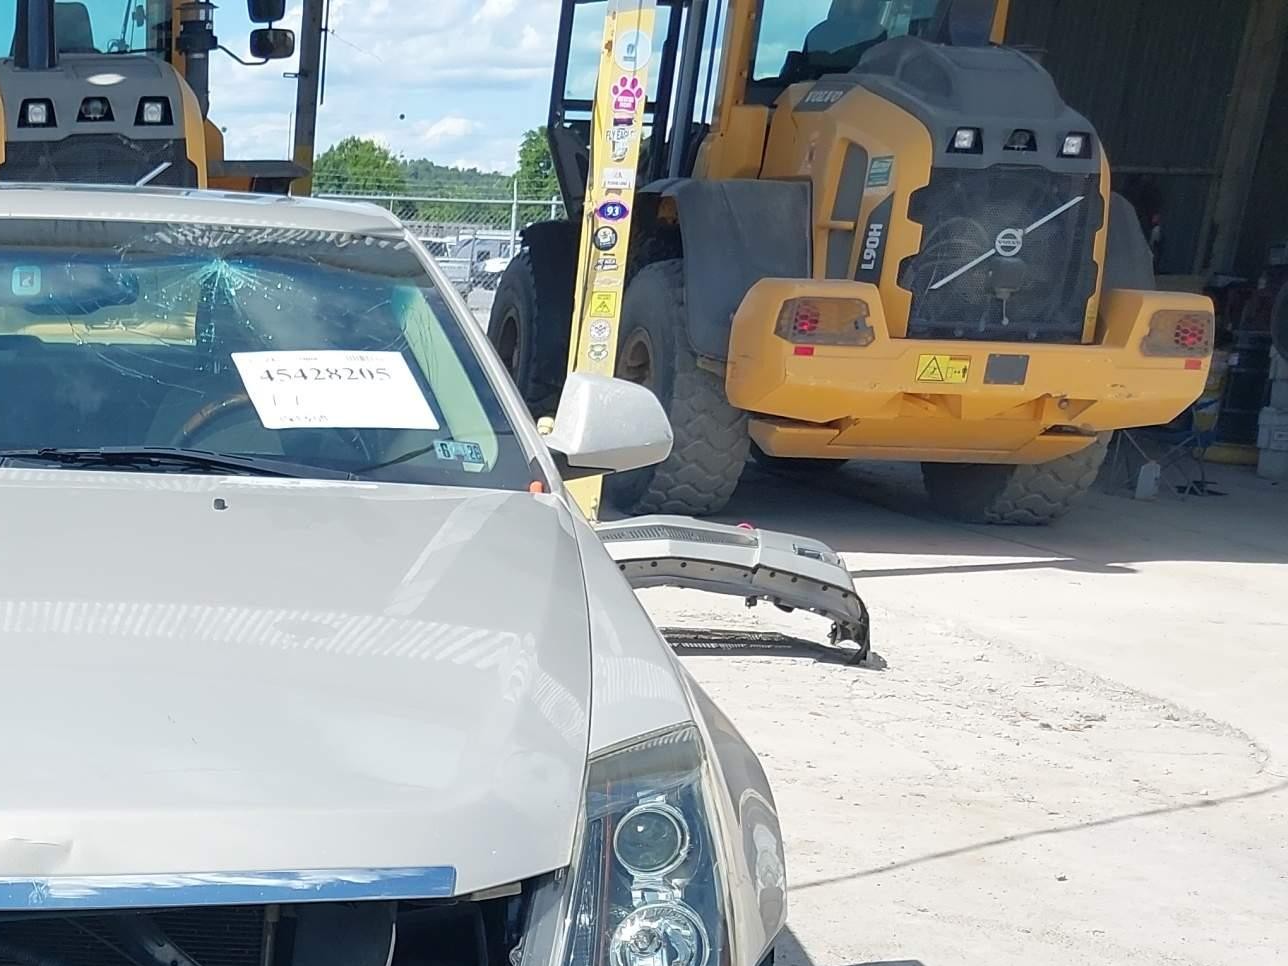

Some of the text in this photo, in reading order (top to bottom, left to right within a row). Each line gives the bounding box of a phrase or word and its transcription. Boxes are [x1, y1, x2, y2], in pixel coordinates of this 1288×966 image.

[805, 90, 843, 103] VOLVO
[606, 206, 619, 217] 93
[861, 223, 884, 270] L90H
[259, 367, 392, 382] 45428205
